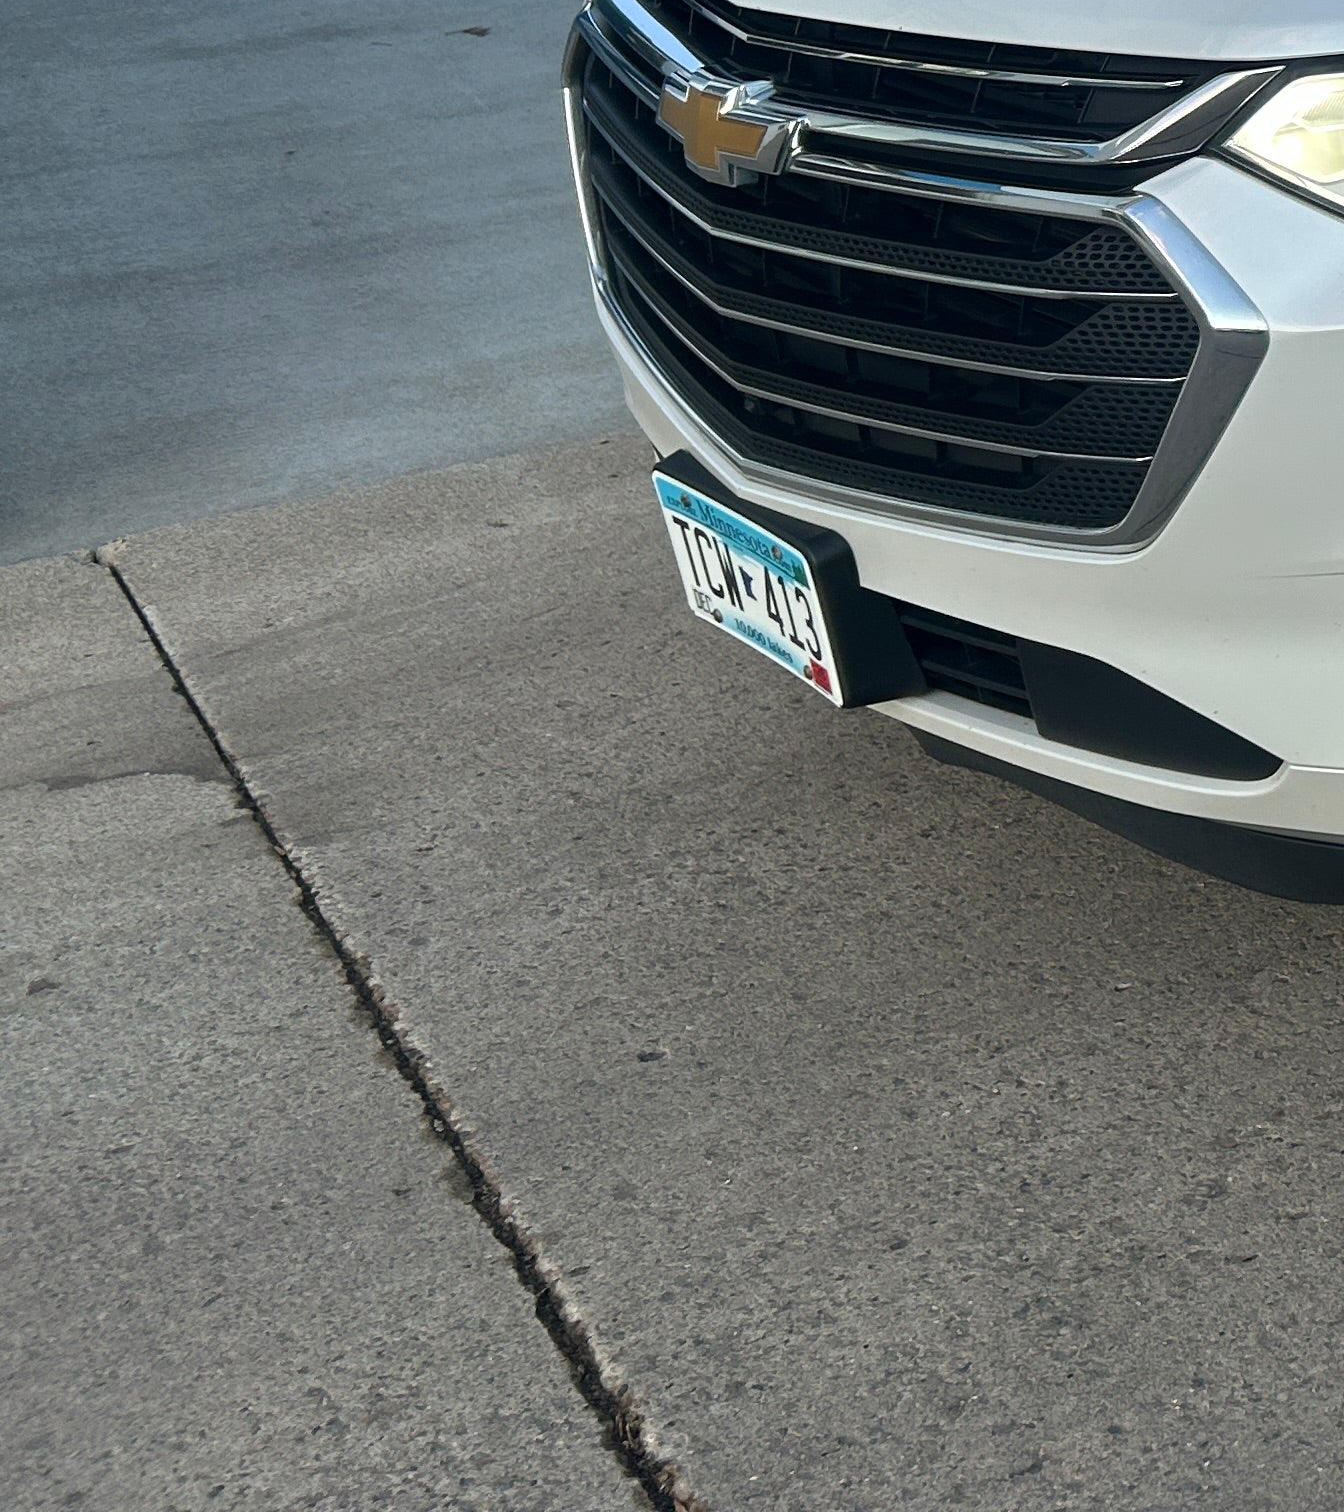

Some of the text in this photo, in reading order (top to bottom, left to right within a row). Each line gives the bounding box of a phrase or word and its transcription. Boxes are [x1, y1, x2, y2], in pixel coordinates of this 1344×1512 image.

[696, 499, 772, 560] Minnesota
[672, 514, 822, 662] TCW 413
